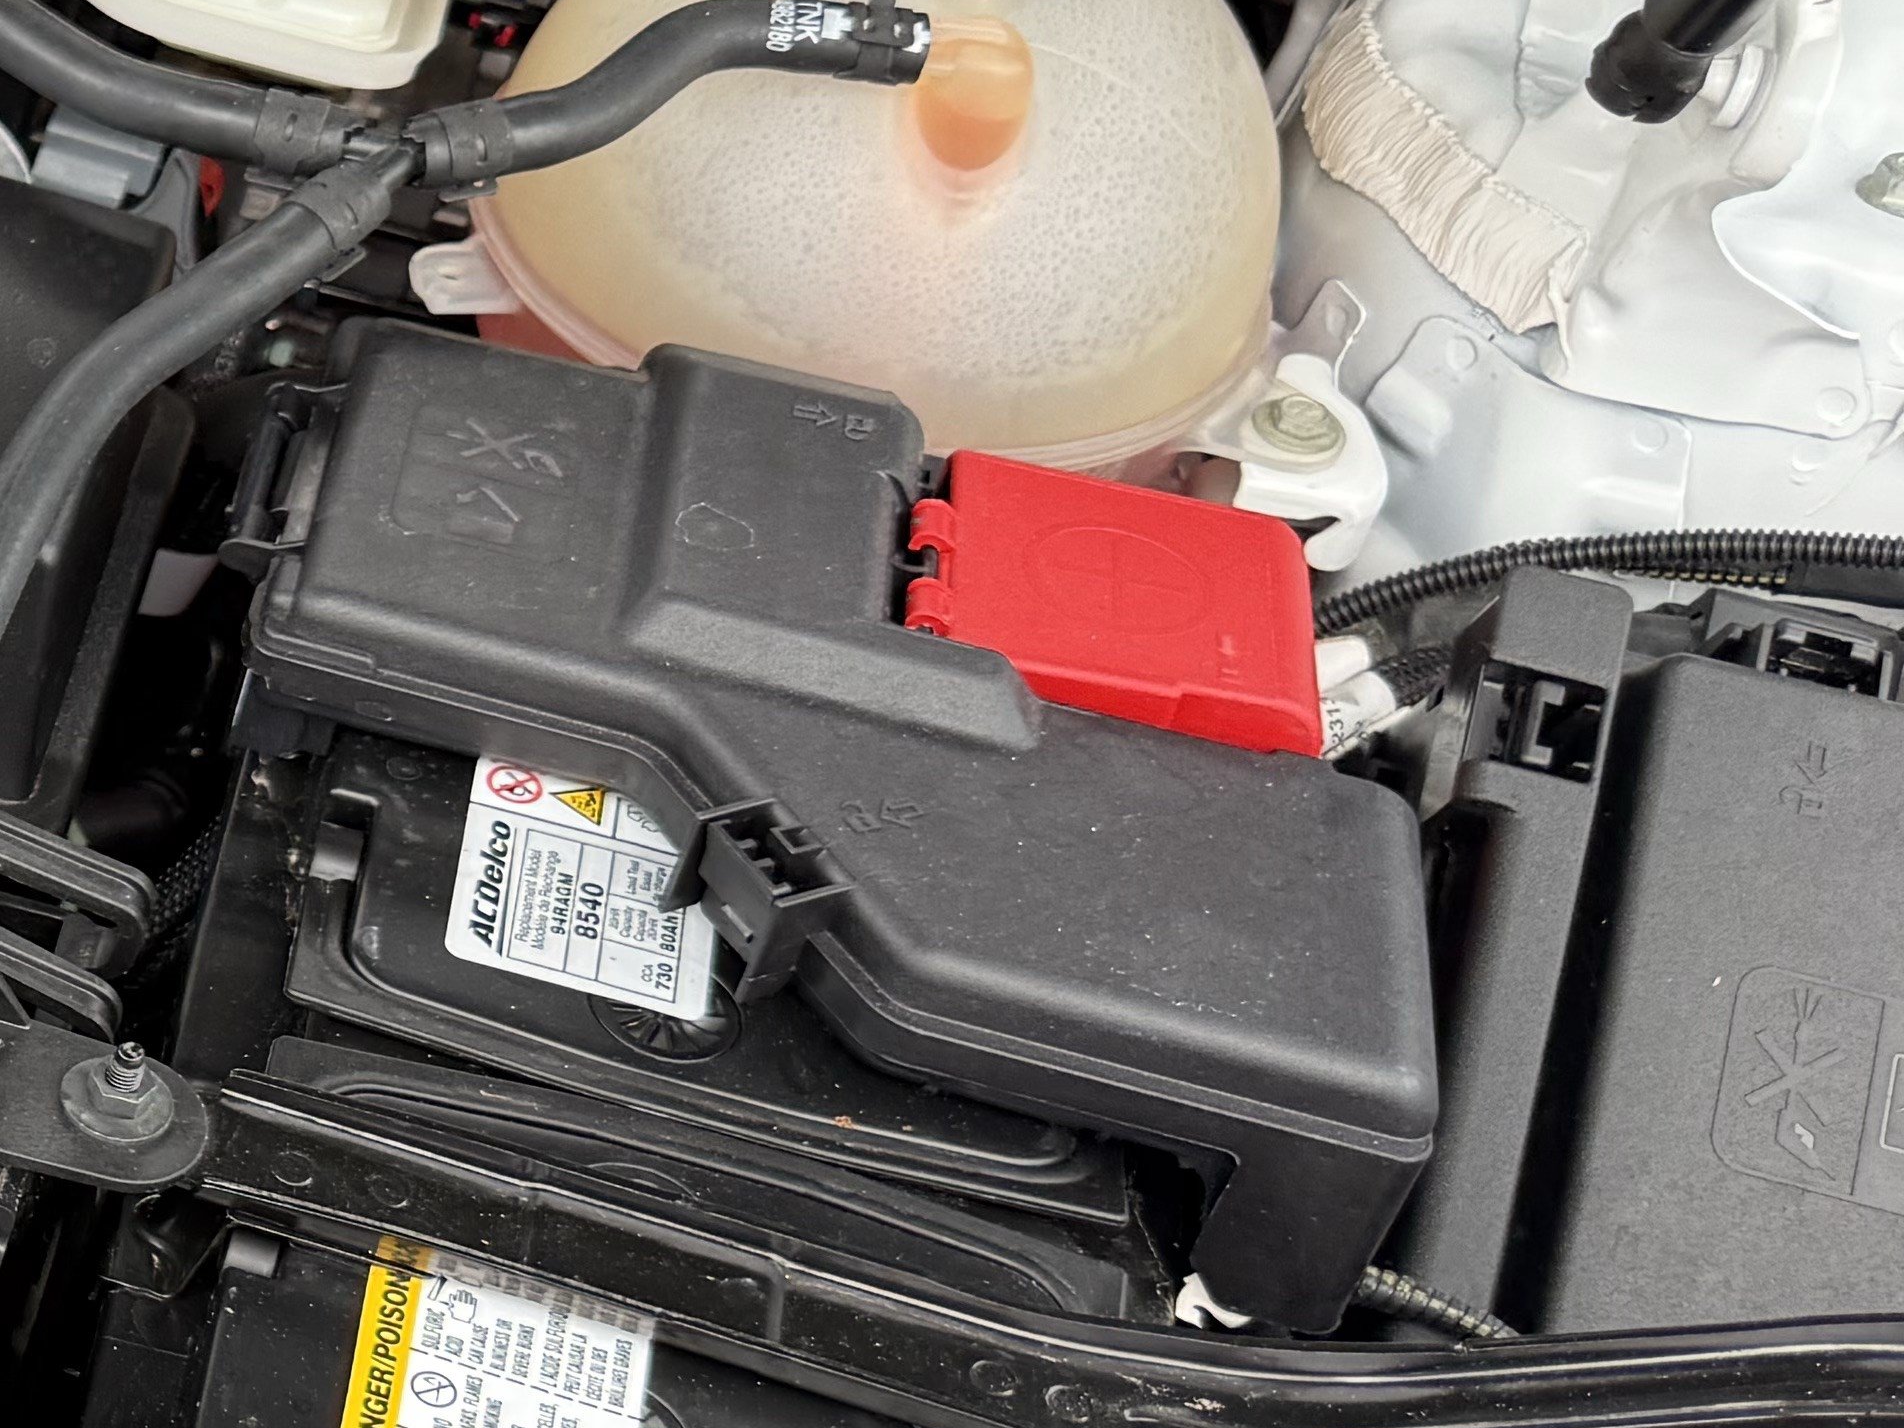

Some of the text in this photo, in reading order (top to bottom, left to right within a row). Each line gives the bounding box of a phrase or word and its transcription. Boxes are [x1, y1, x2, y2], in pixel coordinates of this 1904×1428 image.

[794, 2, 823, 45] TNK
[469, 820, 510, 946] ACDelco
[574, 882, 603, 939] 8540
[659, 915, 678, 951] 80Ah
[640, 964, 653, 982] CCA
[654, 962, 672, 989] 730
